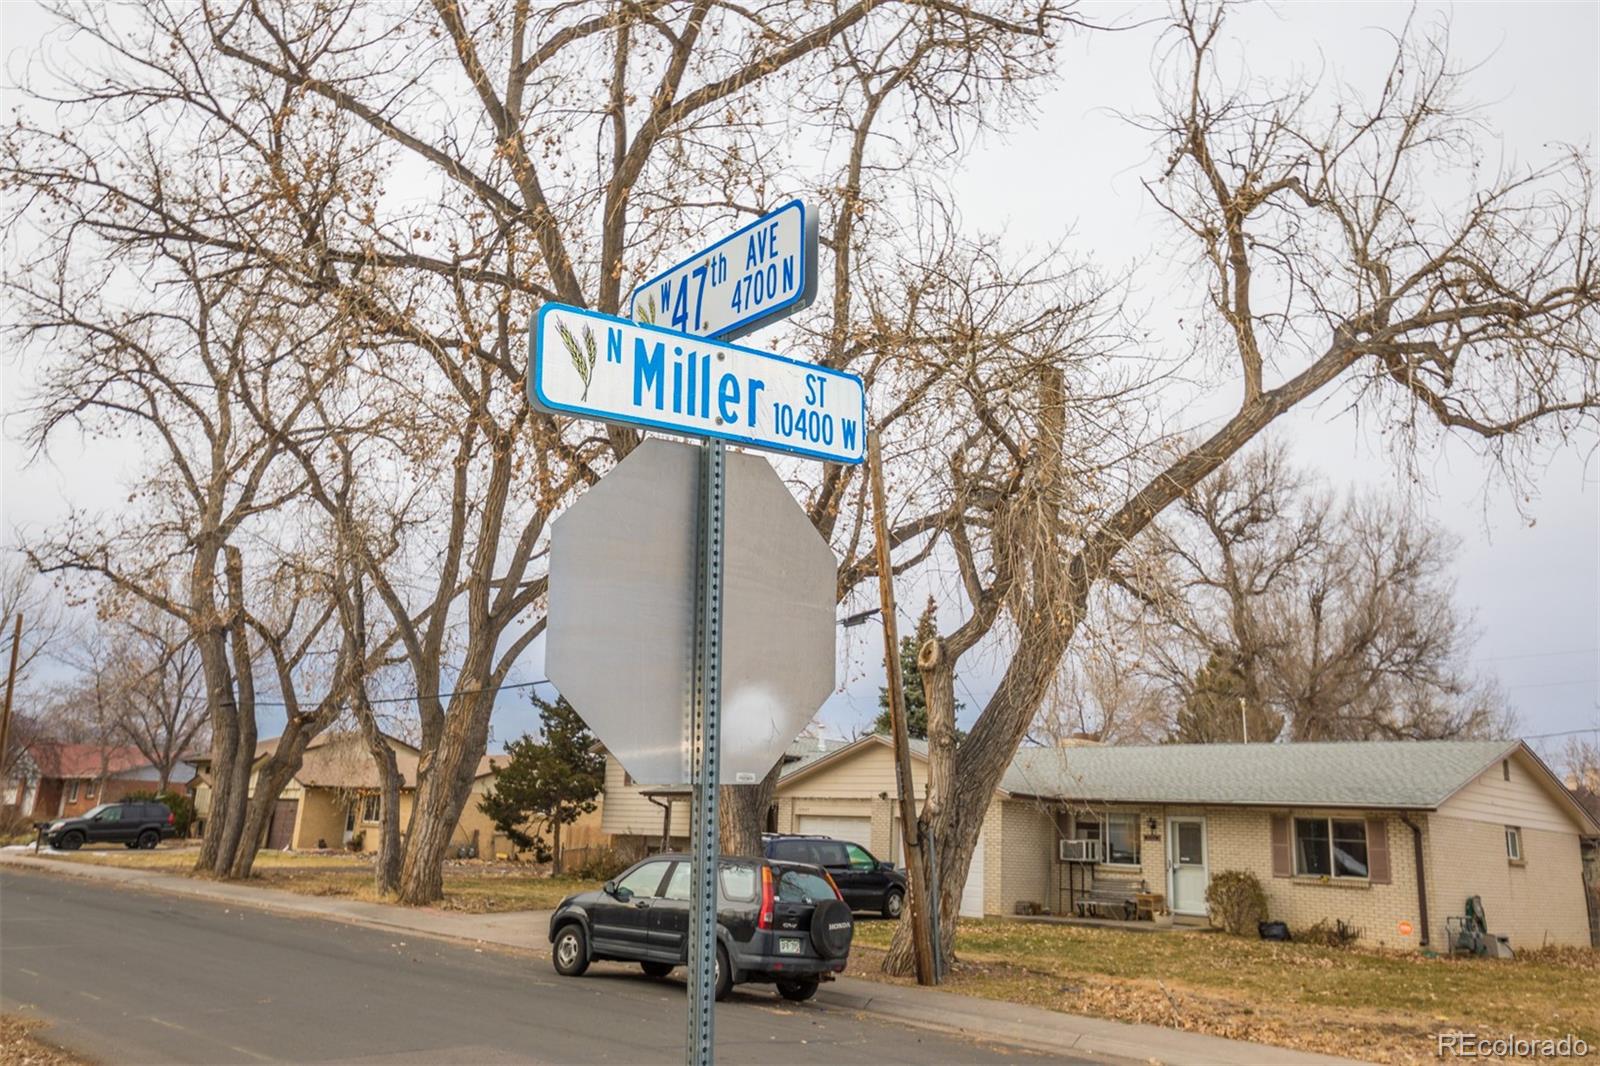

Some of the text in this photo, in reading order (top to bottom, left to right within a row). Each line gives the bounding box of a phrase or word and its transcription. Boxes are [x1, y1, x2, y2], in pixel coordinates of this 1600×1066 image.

[661, 221, 779, 334] W 47th AVE
[731, 255, 794, 314] 4700 N
[607, 327, 827, 427] N Miller ST
[773, 402, 857, 451] 10400 W
[829, 922, 851, 931] HONDA
